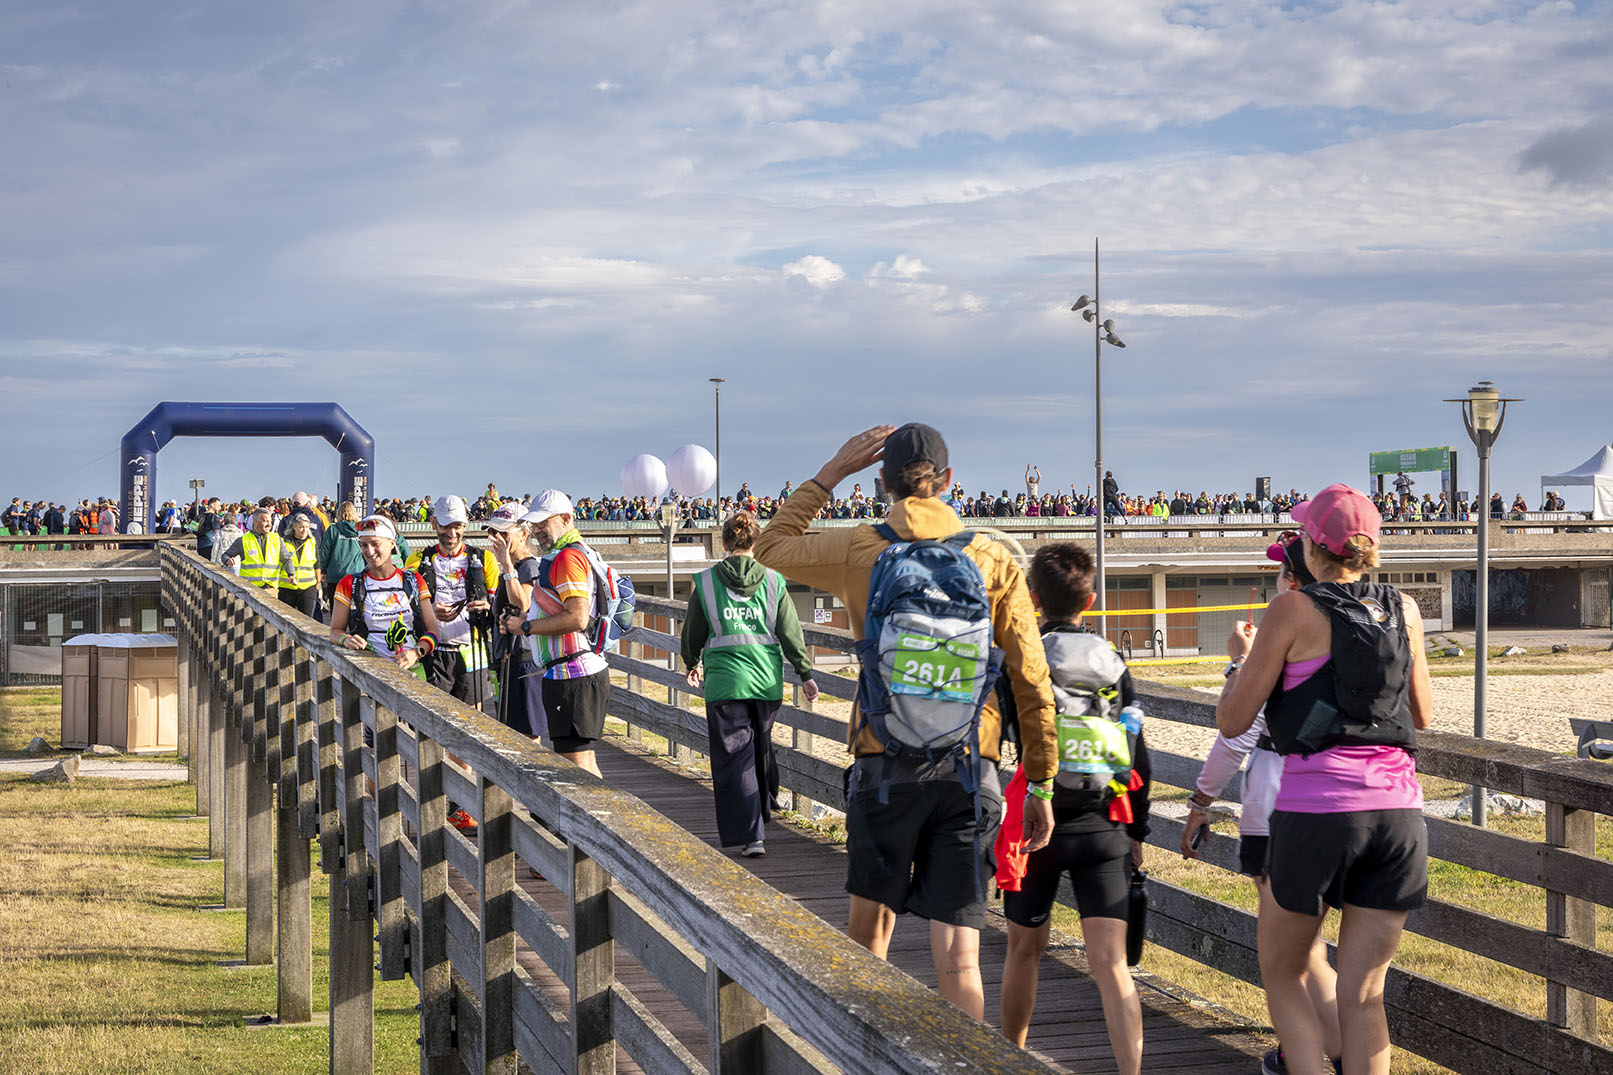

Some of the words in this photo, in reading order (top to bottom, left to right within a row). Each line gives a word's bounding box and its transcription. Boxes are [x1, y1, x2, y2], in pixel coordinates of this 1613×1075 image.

[127, 490, 134, 500] DE
[723, 607, 763, 620] OXFAM
[902, 659, 962, 689] 261A
